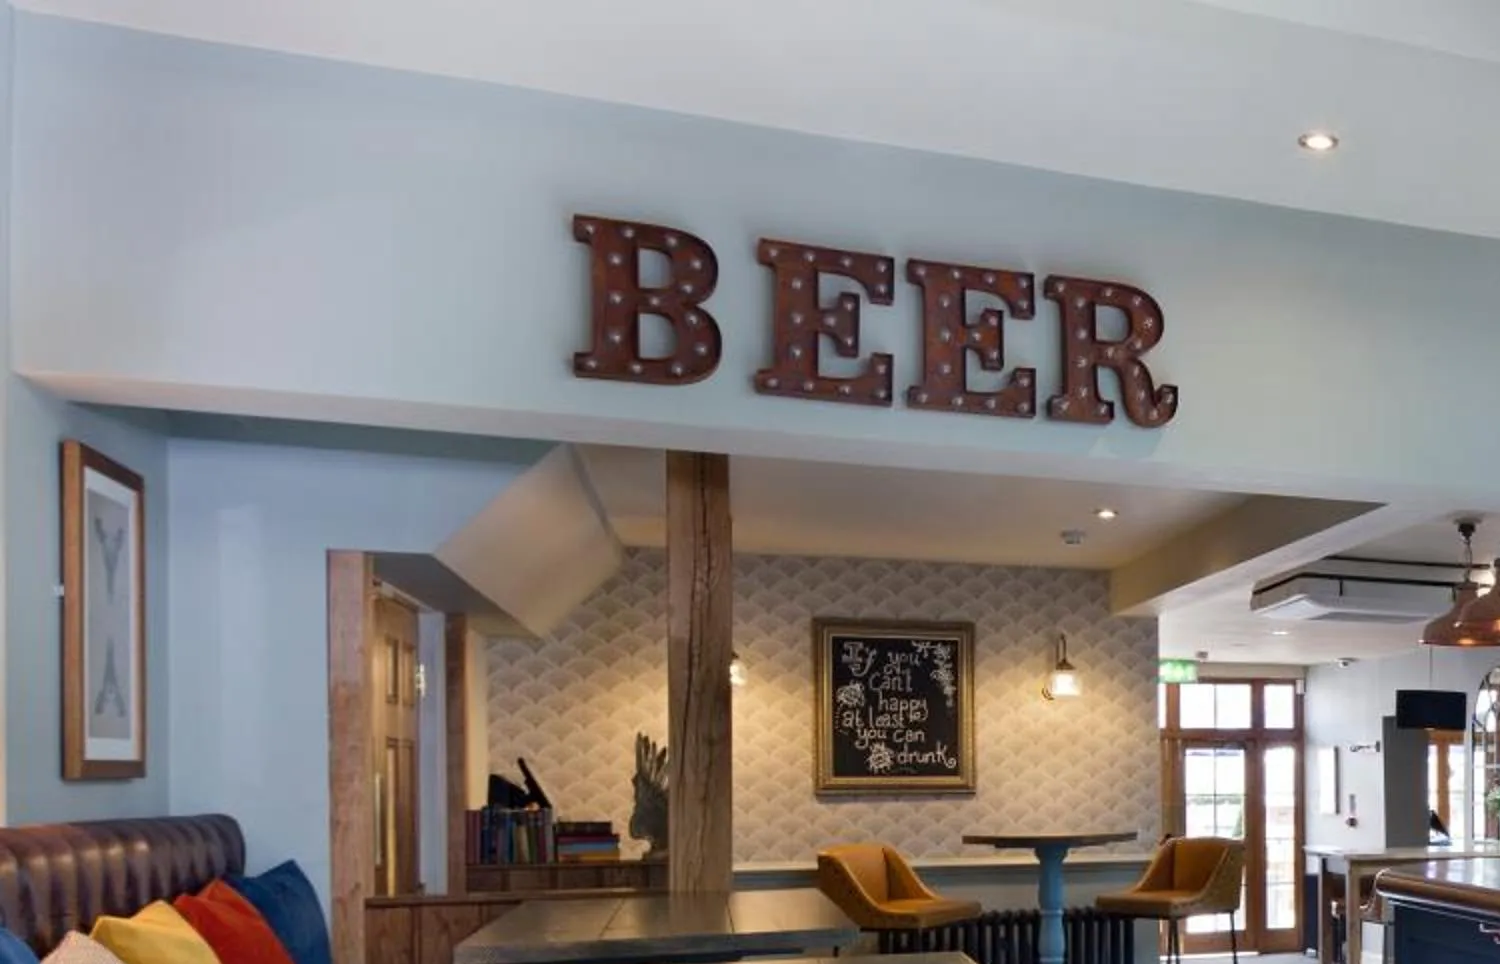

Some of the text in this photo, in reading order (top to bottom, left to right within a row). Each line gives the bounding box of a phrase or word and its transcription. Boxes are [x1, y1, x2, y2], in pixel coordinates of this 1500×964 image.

[573, 214, 1179, 428] BEER
[884, 652, 920, 676] you
[842, 709, 865, 728] at
[878, 690, 929, 722] happy
[855, 728, 925, 750] you can
[897, 741, 957, 769] drunk
